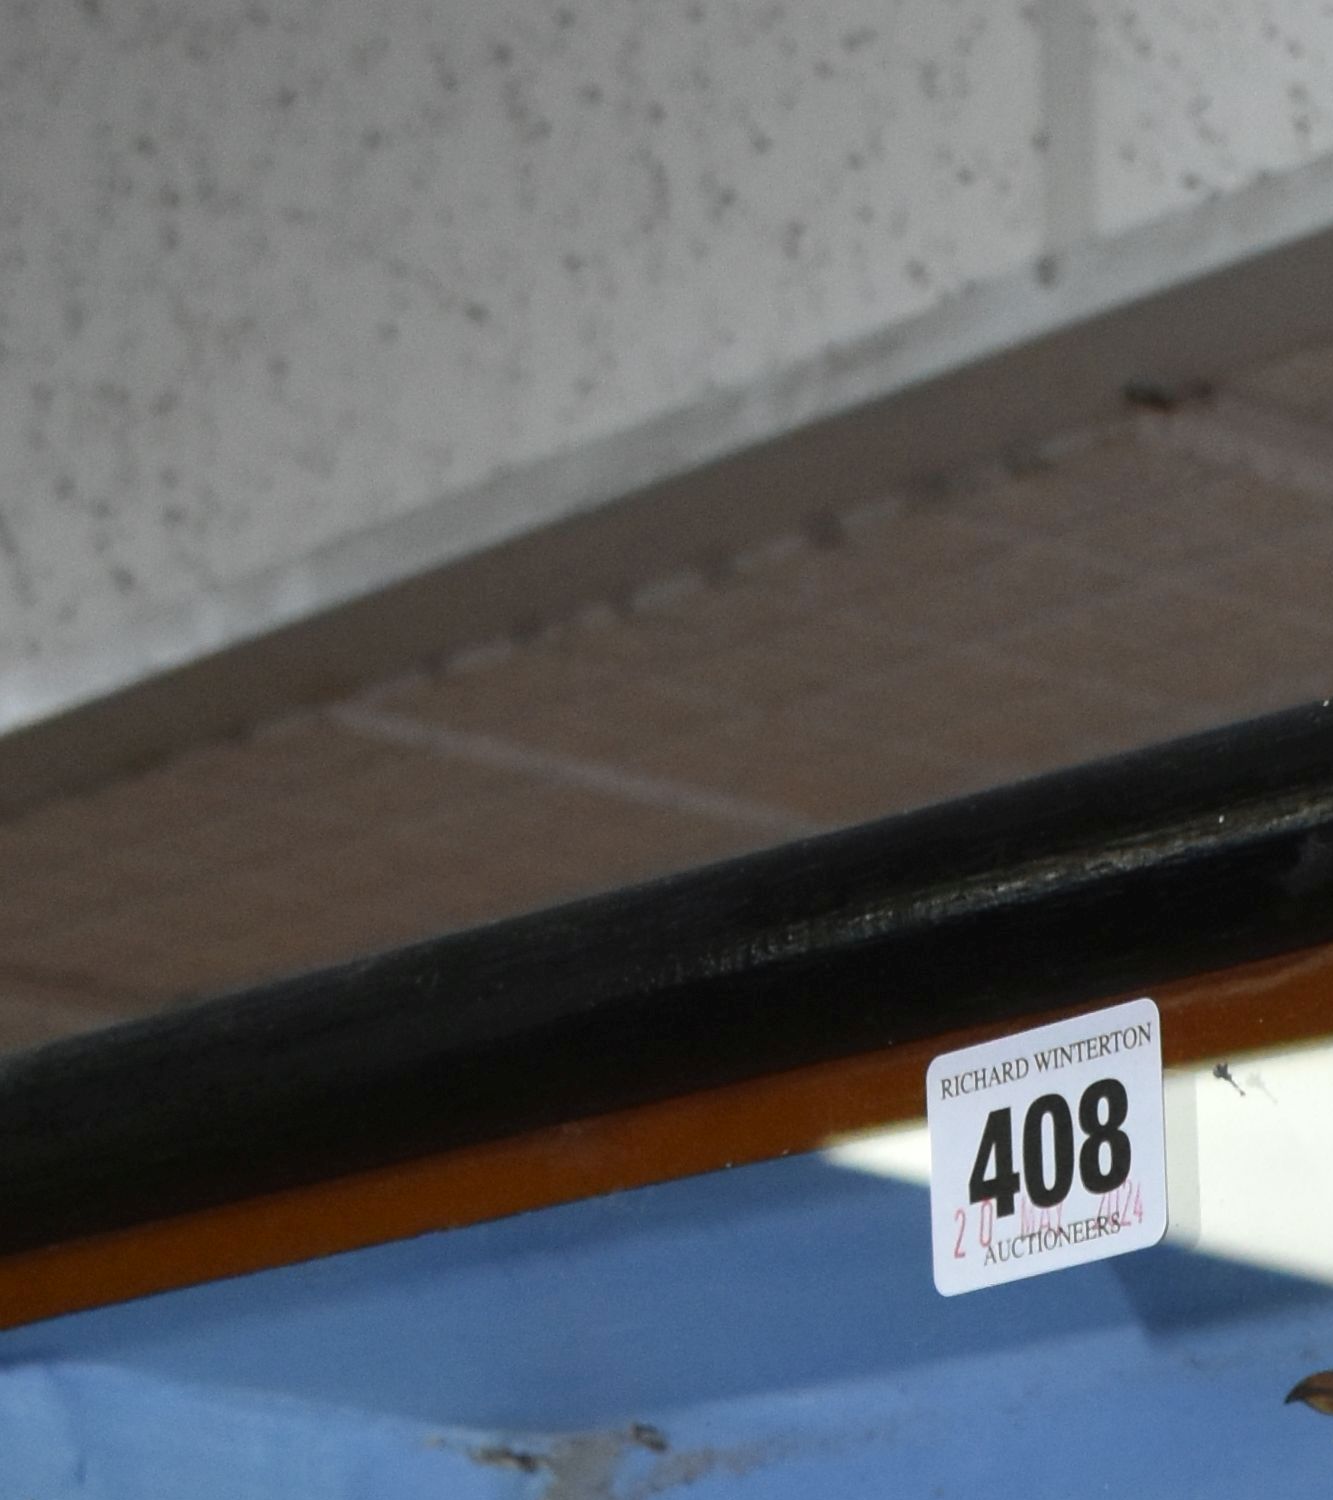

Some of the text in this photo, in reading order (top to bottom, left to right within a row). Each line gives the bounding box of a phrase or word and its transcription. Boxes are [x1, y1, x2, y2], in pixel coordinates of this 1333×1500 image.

[940, 1023, 1152, 1100] RICHARD WINTERTON
[968, 1078, 1132, 1218] 408
[983, 1211, 1121, 1266] AUCTIONEERS
